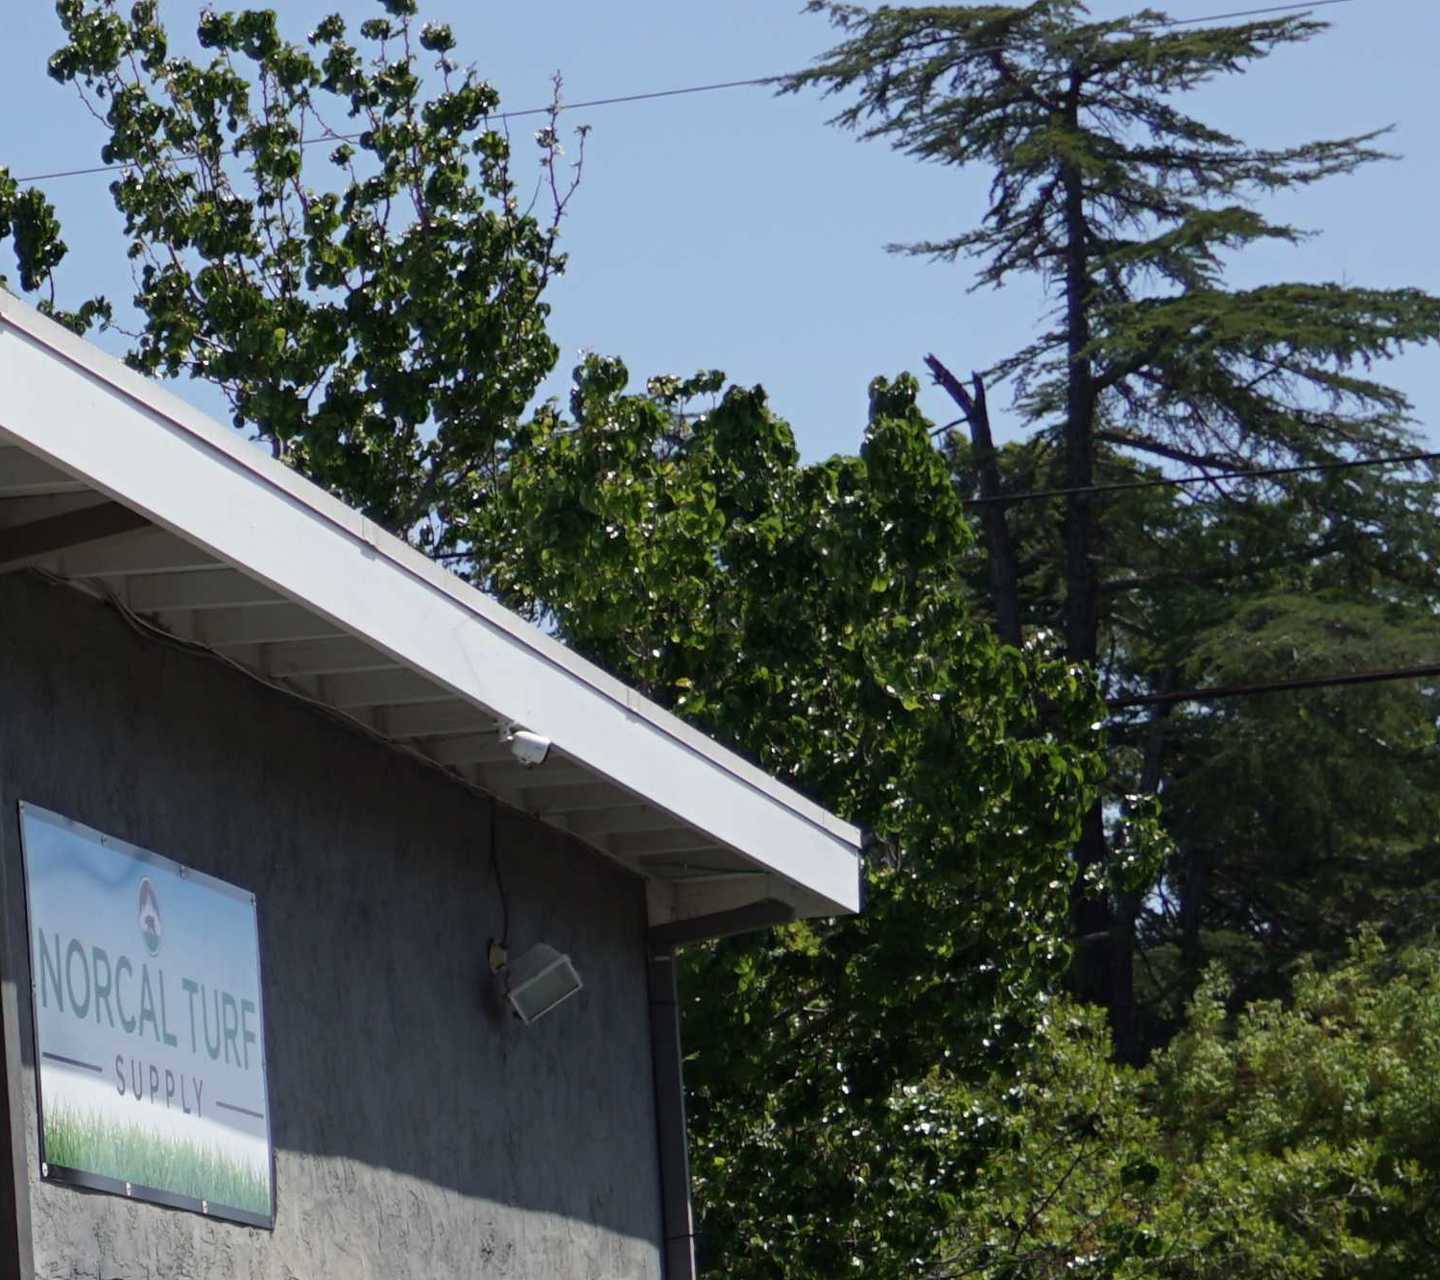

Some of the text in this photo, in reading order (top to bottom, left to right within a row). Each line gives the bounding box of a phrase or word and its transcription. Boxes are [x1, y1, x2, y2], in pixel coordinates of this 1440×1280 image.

[37, 925, 258, 1071] NORCAL TURF
[114, 1054, 205, 1118] SUPPLY
